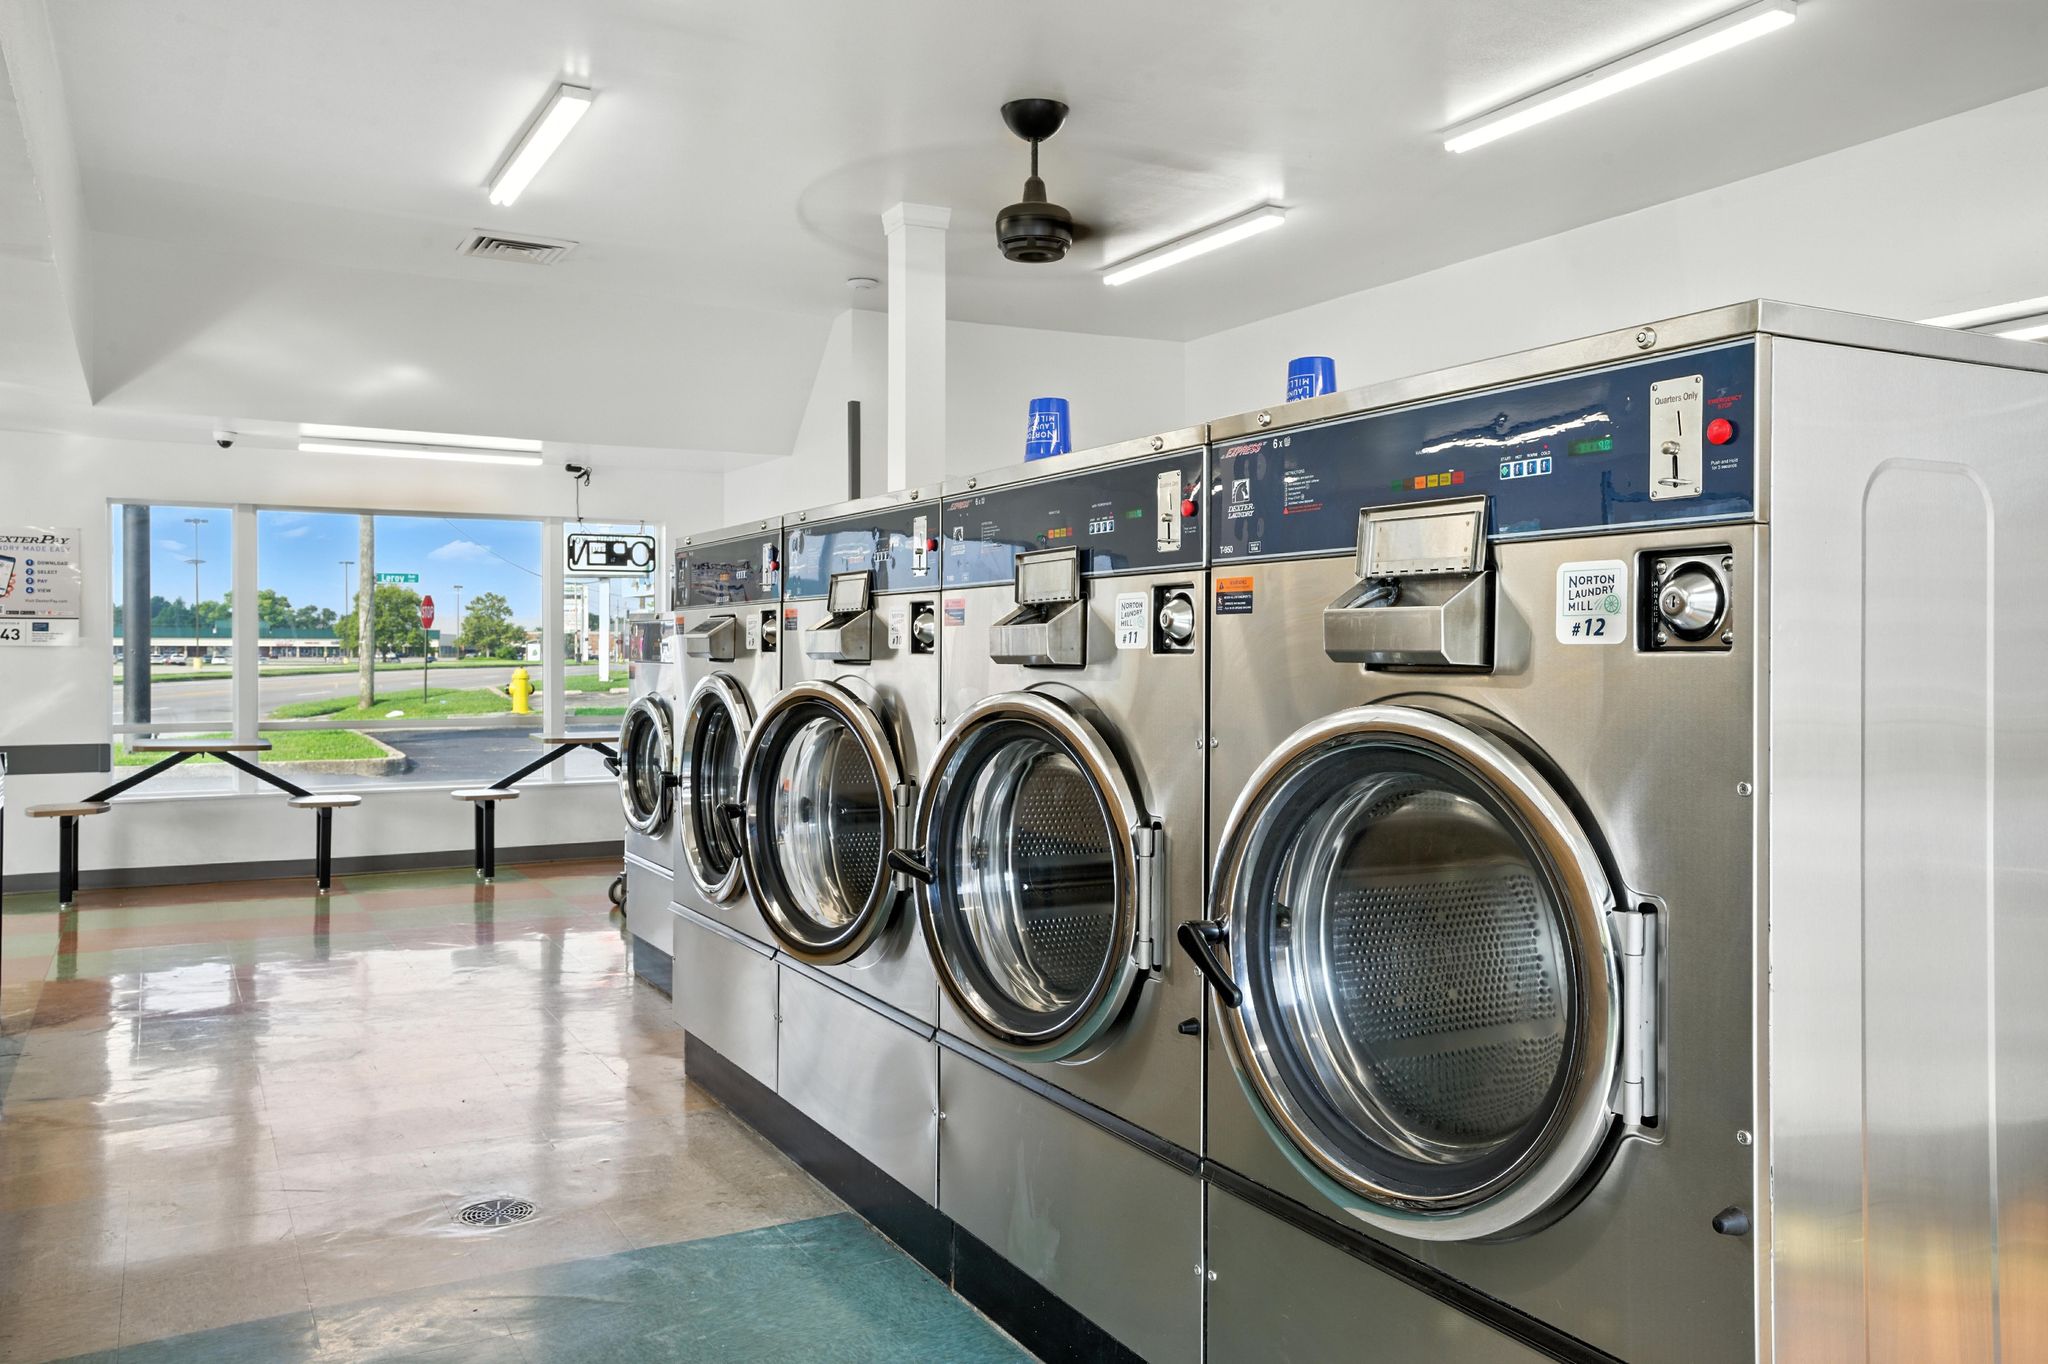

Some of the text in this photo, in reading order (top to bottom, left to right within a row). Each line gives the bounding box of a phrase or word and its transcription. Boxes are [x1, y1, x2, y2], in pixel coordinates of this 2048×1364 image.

[1654, 391, 1698, 405] Quarters Only
[1228, 503, 1254, 512] DEXTER
[381, 573, 405, 584] Leroy
[1569, 575, 1616, 588] NORTON
[1569, 585, 1615, 601] LAUNDRY
[422, 604, 435, 619] STOP
[1121, 601, 1143, 611] NORTON
[1568, 600, 1593, 611] MILL
[1571, 617, 1606, 637] #12
